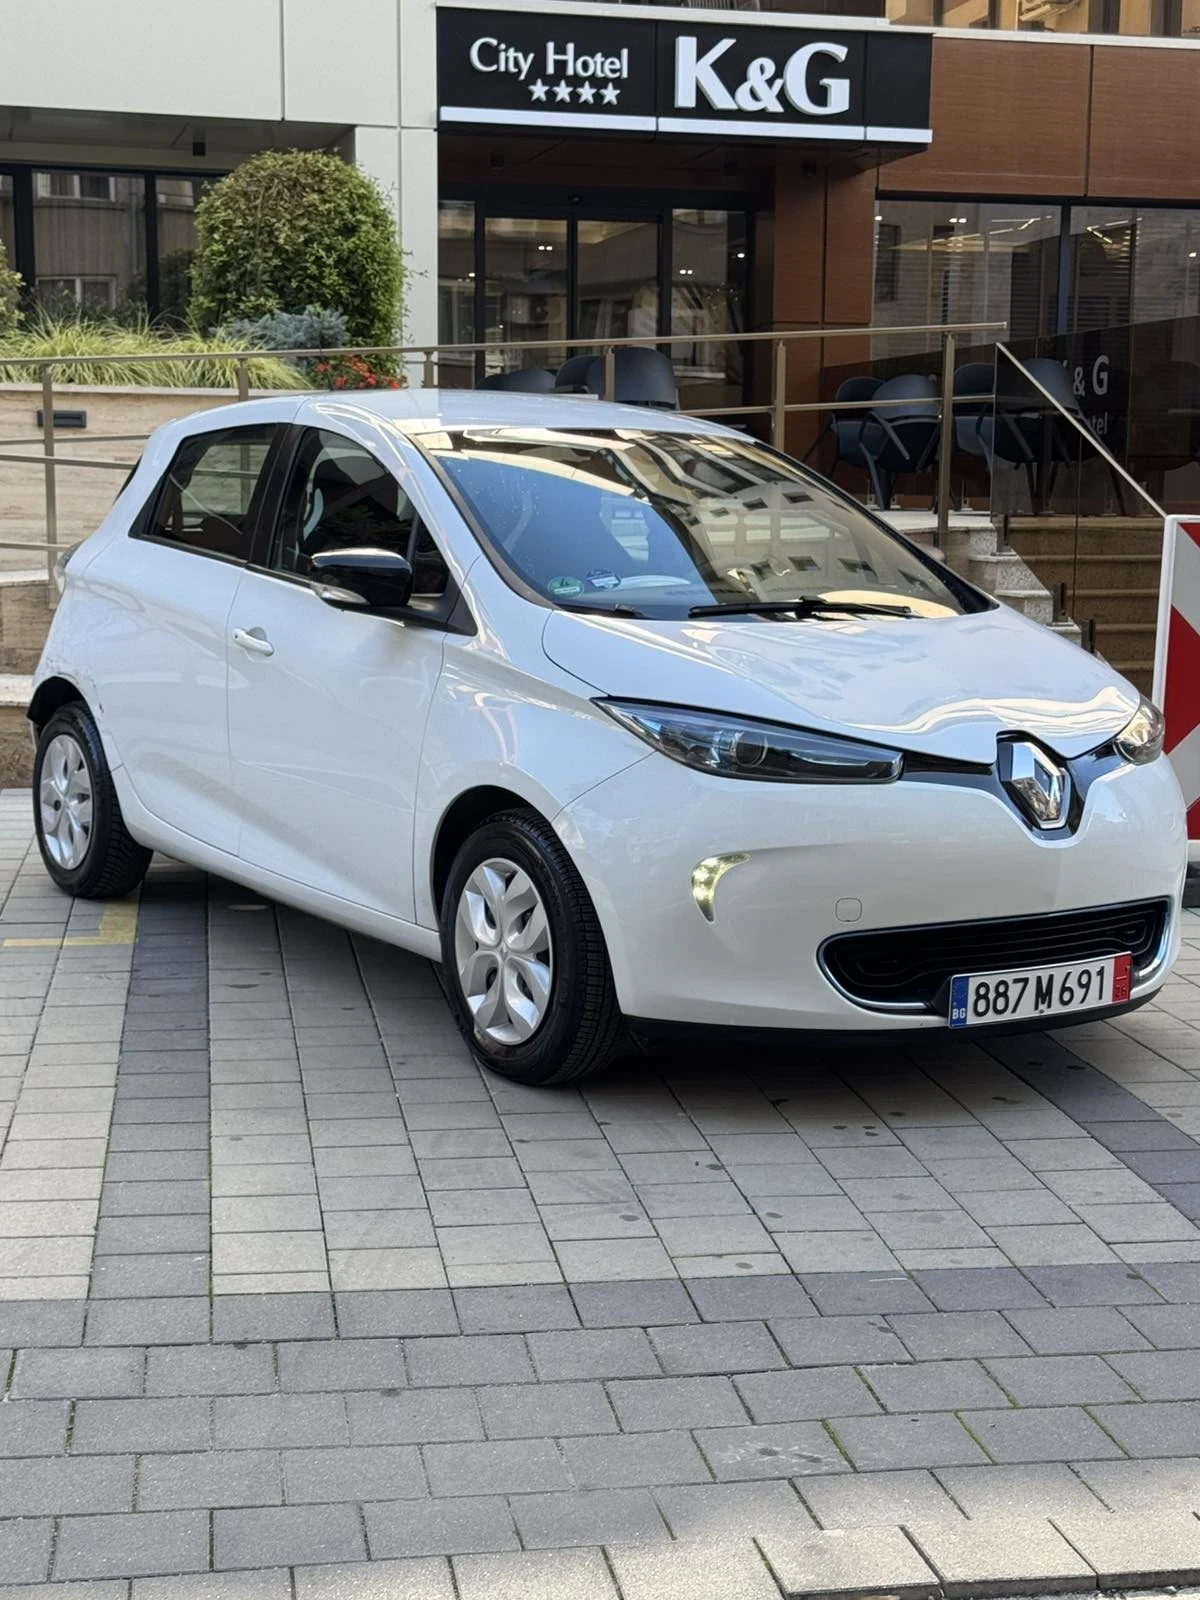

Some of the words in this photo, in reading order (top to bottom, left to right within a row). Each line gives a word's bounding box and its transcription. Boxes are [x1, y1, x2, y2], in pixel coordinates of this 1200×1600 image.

[469, 37, 535, 81] City
[545, 41, 629, 80] Hotel
[673, 35, 851, 117] K&G
[952, 1007, 966, 1020] BG
